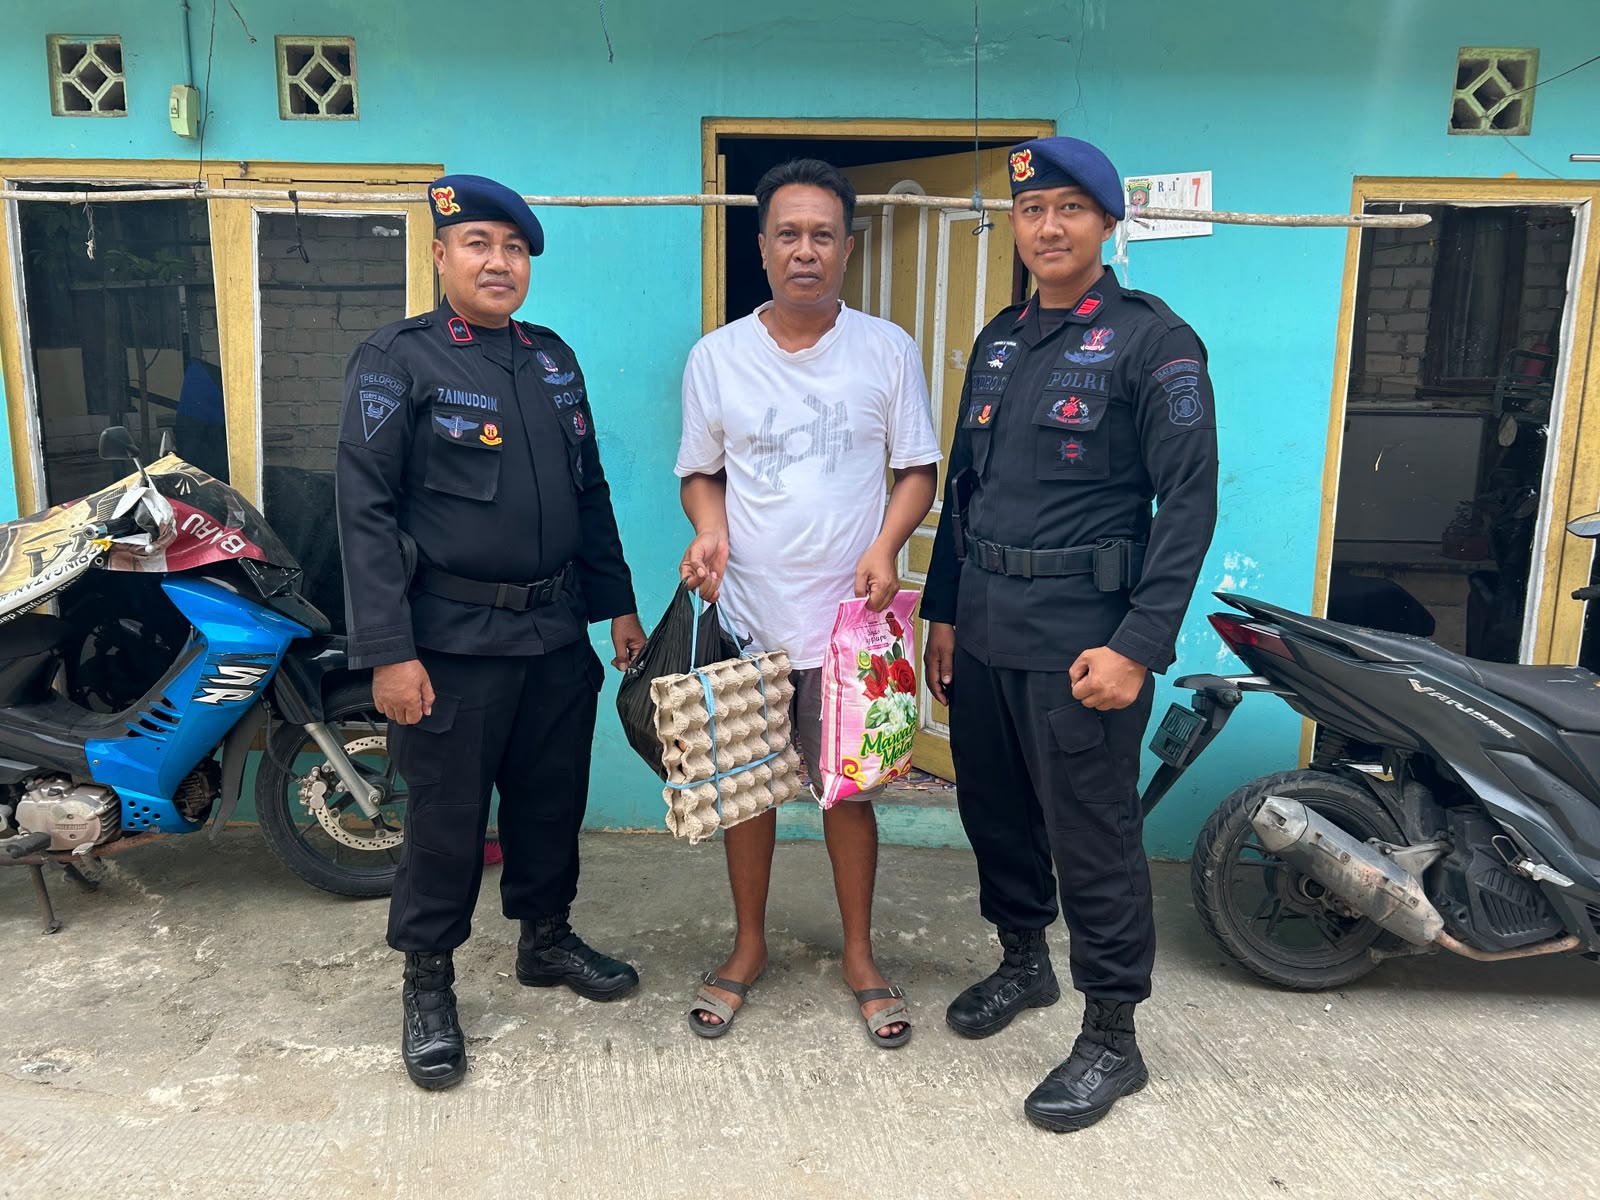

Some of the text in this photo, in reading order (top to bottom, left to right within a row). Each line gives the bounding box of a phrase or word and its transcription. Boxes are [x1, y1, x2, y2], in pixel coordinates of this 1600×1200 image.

[1192, 178, 1201, 207] 7
[363, 374, 403, 394] PELOPOR
[1047, 372, 1106, 392] POLRI
[437, 388, 498, 412] ZAINUDDIN
